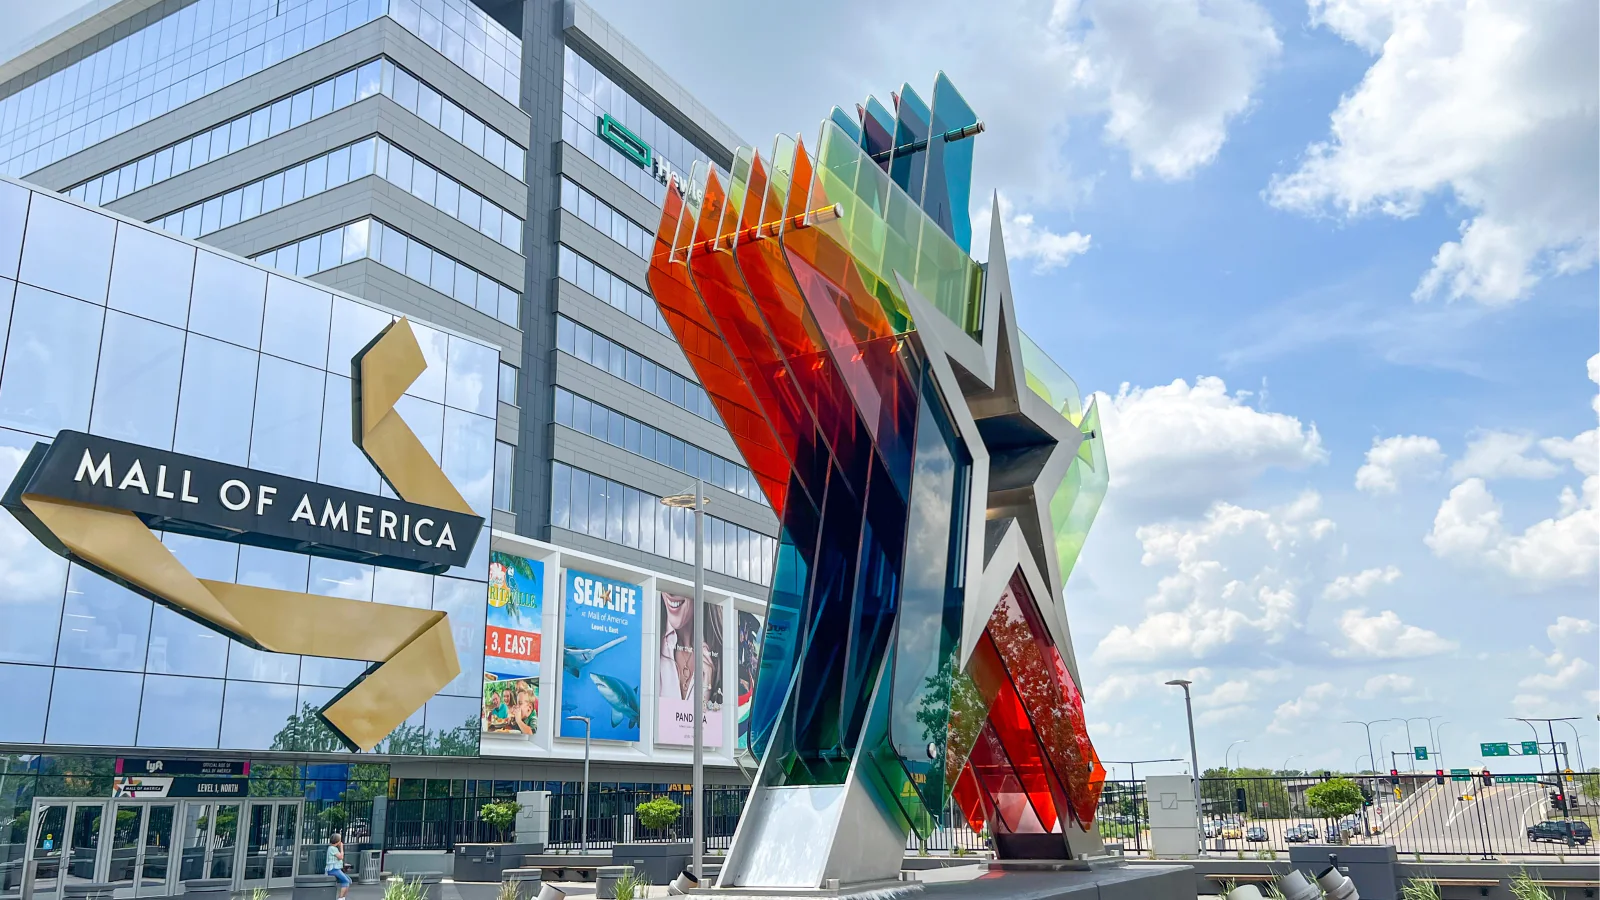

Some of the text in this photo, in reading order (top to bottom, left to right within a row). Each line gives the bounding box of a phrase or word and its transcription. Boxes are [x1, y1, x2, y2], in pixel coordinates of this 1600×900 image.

[74, 448, 457, 551] MALL OF AMERICA
[573, 576, 604, 609] SEA
[588, 610, 600, 620] Mall
[601, 613, 607, 621] of
[607, 615, 629, 626] America
[491, 631, 533, 656] 3, EAST
[675, 712, 708, 724] PANDA
[197, 783, 214, 793] LEVEL
[220, 784, 239, 793] NORTH
